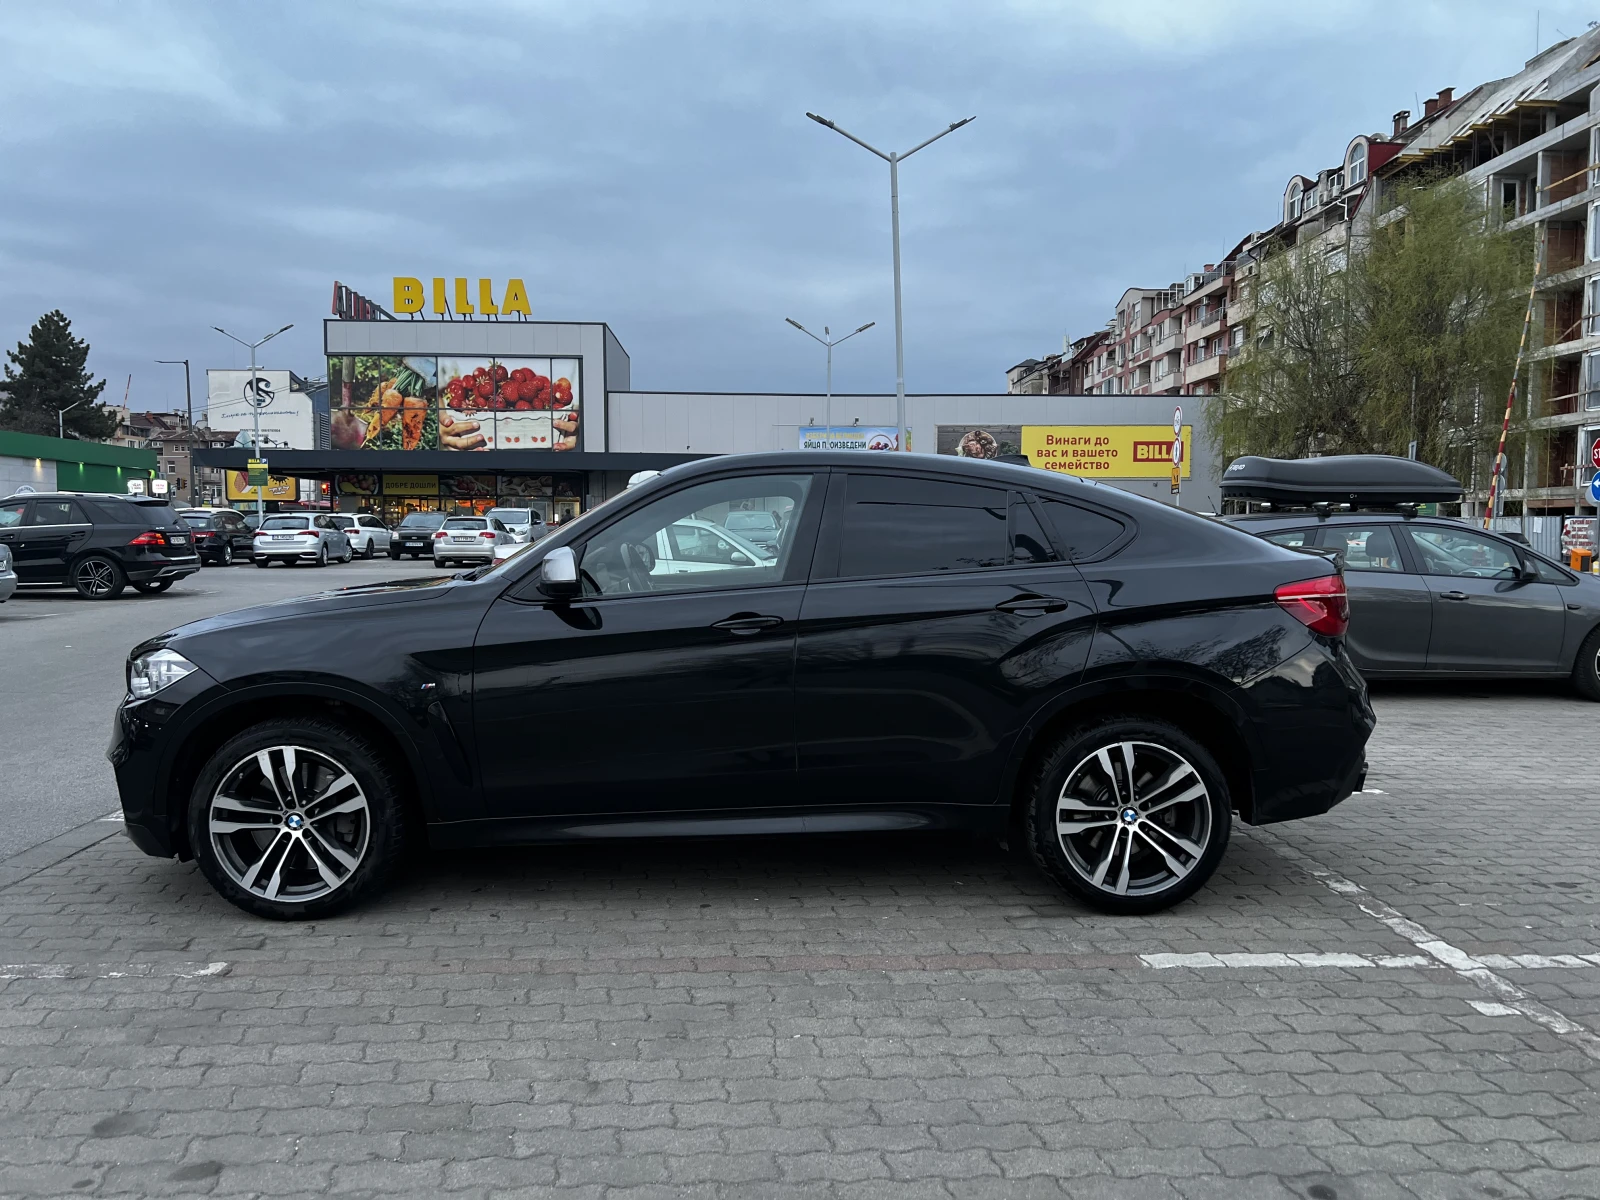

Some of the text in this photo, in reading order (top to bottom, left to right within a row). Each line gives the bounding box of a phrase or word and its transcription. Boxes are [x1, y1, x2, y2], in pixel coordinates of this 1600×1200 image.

[393, 277, 532, 315] BILLA
[804, 440, 866, 449] ЯЙЦА ПОИЗВЕДЕНИ
[1046, 435, 1110, 447] Винаги до
[1037, 449, 1118, 458] вас и вашето
[1044, 459, 1110, 470] семейство
